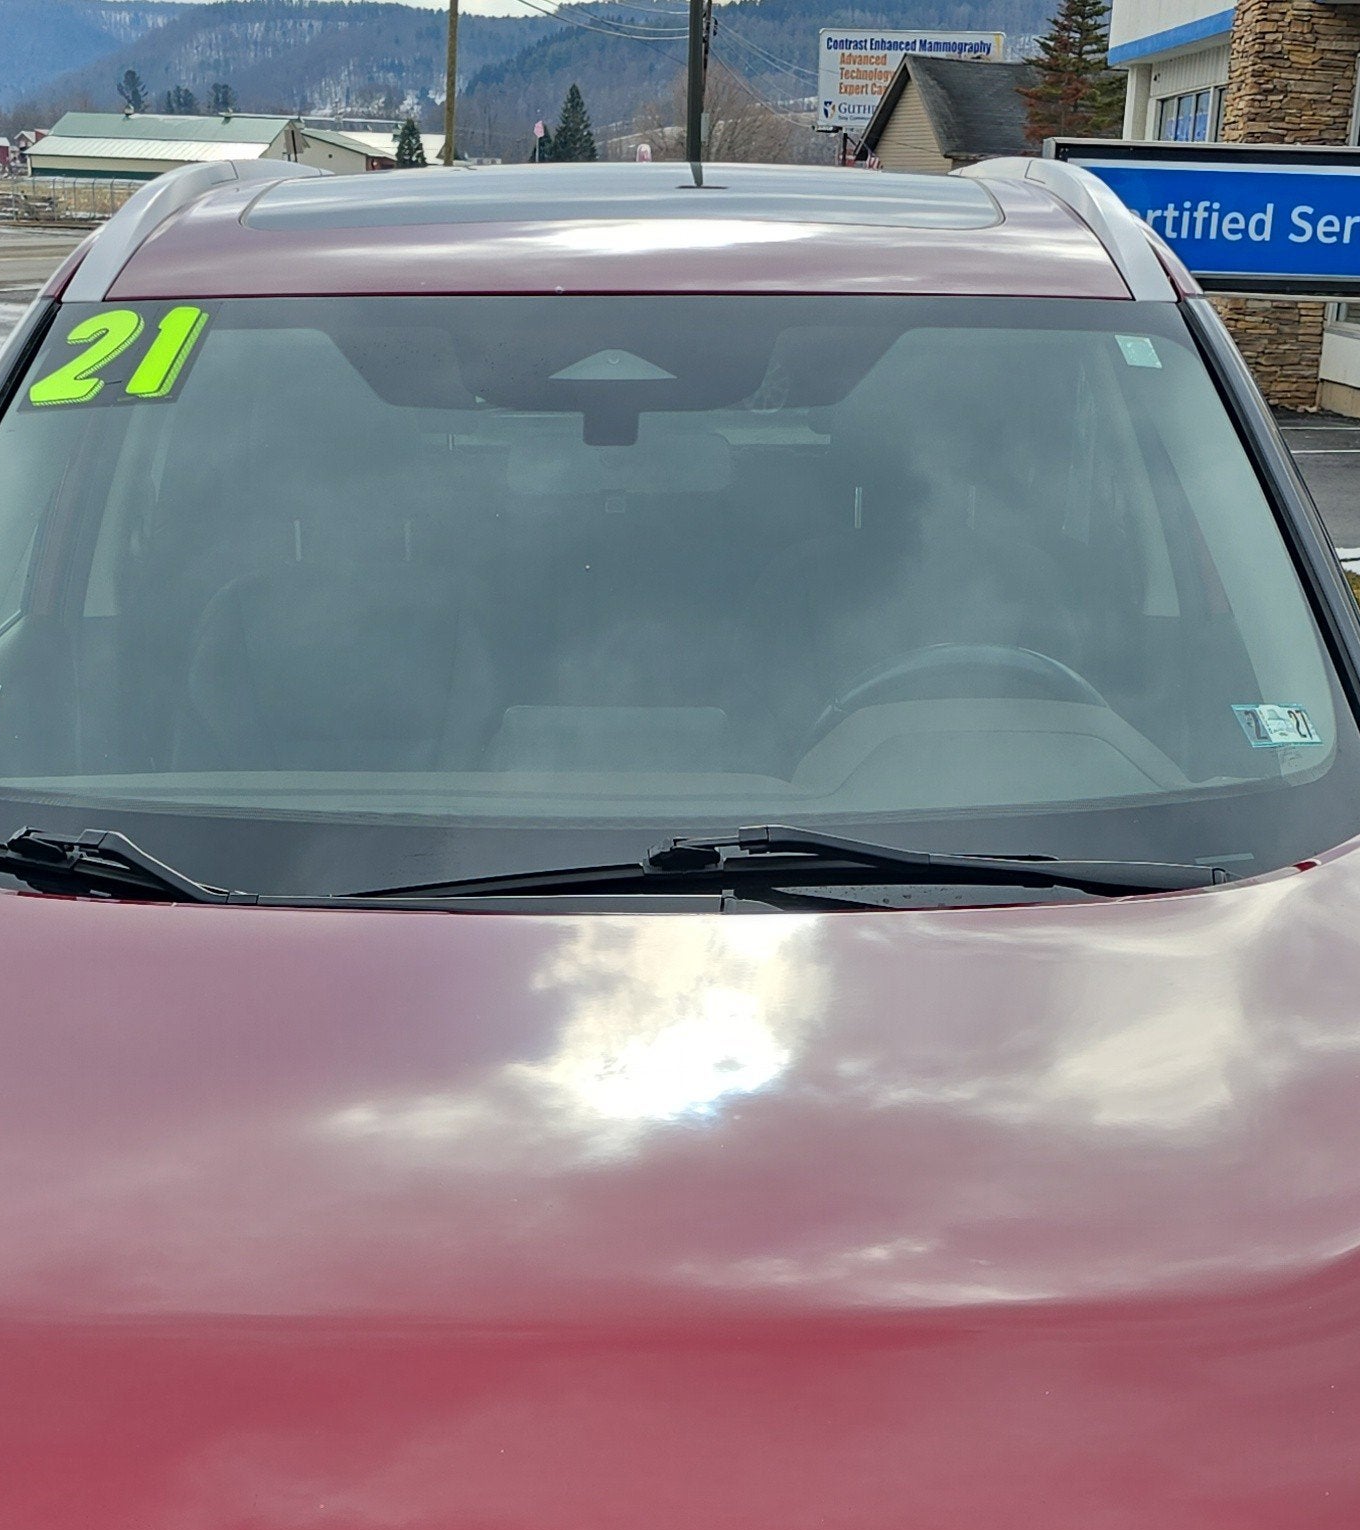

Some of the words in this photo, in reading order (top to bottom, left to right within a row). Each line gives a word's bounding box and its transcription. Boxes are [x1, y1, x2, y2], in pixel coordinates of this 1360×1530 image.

[826, 37, 868, 51] Contrast
[870, 37, 917, 52] Enhanced
[919, 39, 992, 56] Mammography
[840, 53, 887, 66] Advanced
[839, 82, 869, 96] Expert
[29, 306, 210, 406] 21
